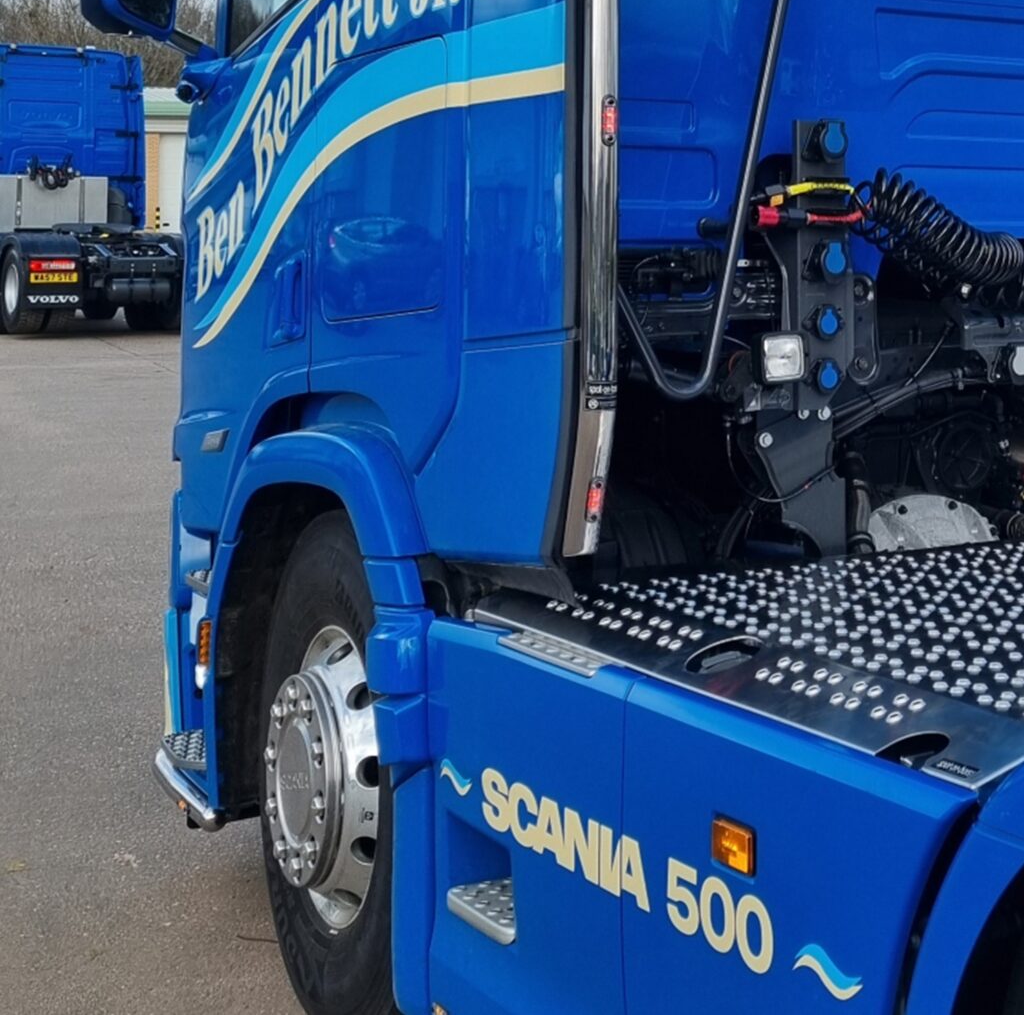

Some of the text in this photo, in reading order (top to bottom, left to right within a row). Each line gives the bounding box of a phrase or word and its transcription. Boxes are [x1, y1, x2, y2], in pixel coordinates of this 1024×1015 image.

[28, 295, 79, 303] VOLVO
[193, 179, 245, 304] Ben
[481, 767, 774, 975] SCANIA 500
